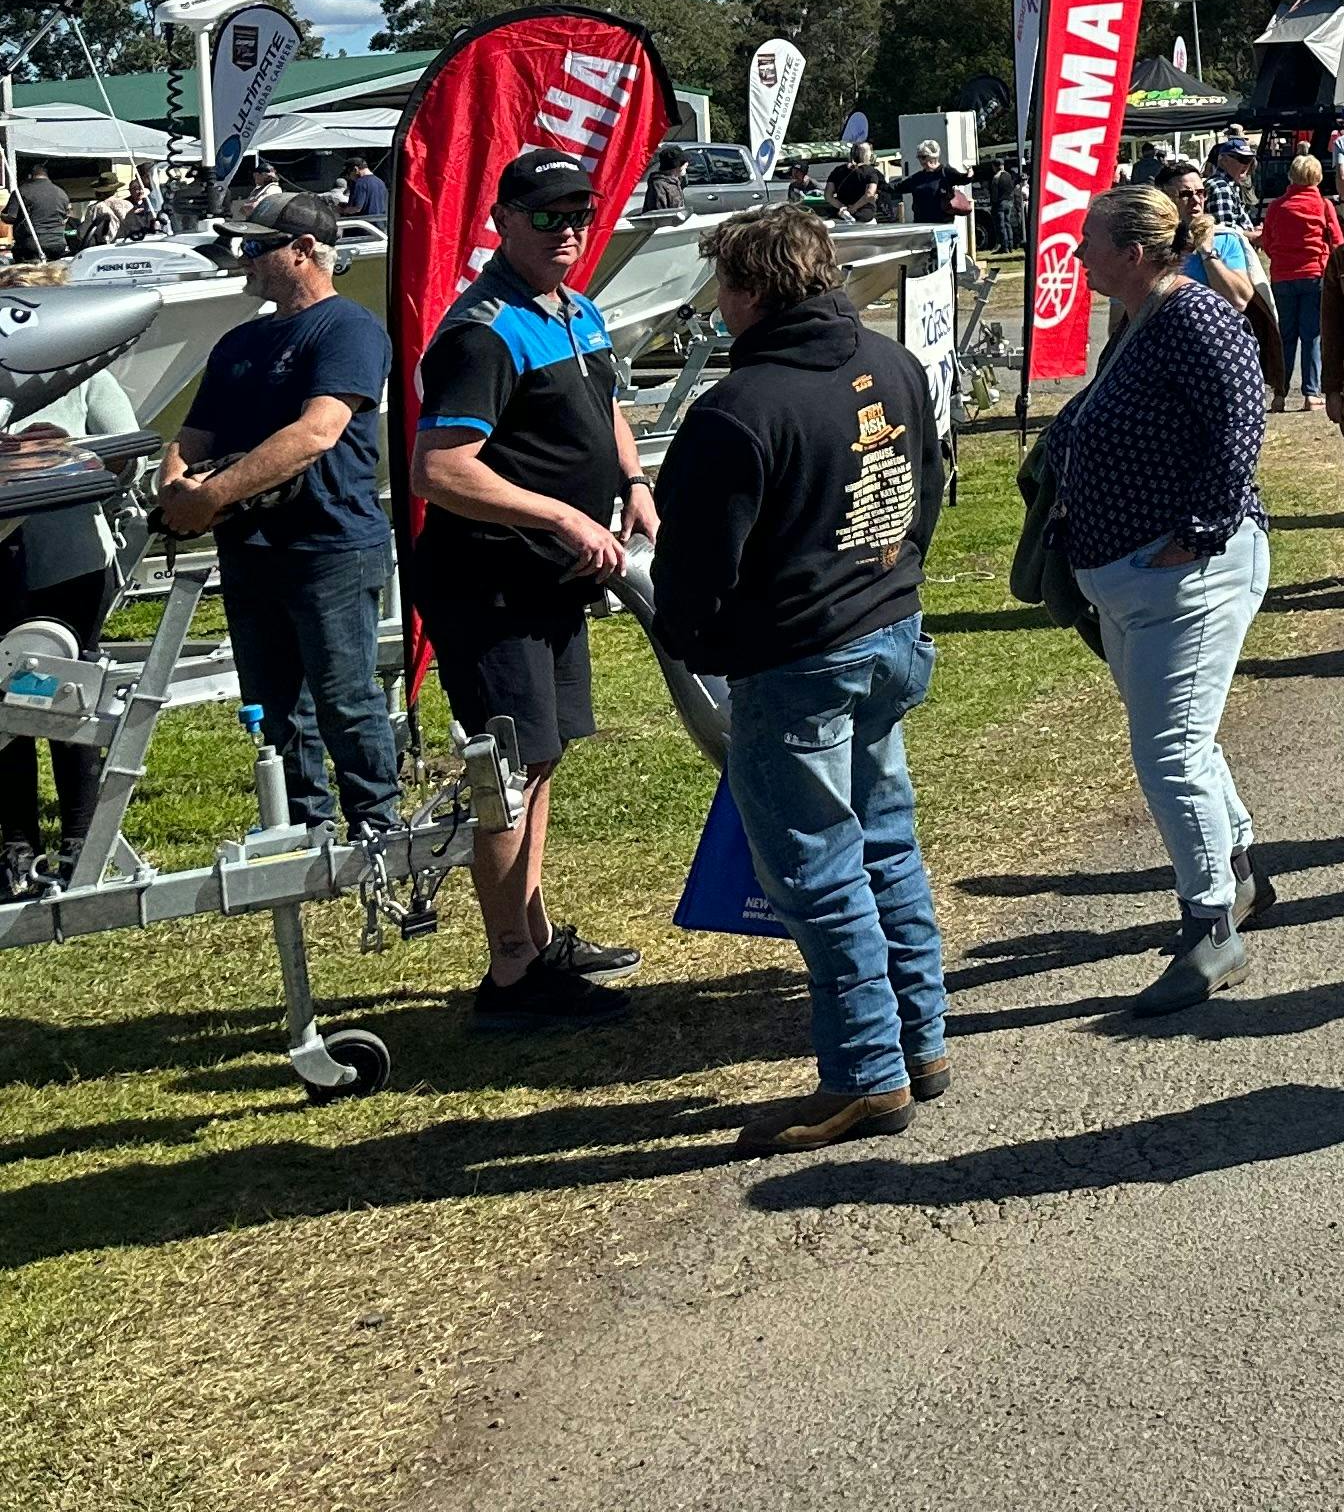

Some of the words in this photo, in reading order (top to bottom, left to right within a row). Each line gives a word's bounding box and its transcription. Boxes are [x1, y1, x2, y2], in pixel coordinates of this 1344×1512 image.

[233, 30, 285, 133] ULTIMATE
[255, 83, 274, 113] ROAD
[270, 38, 296, 84] CAMPERS
